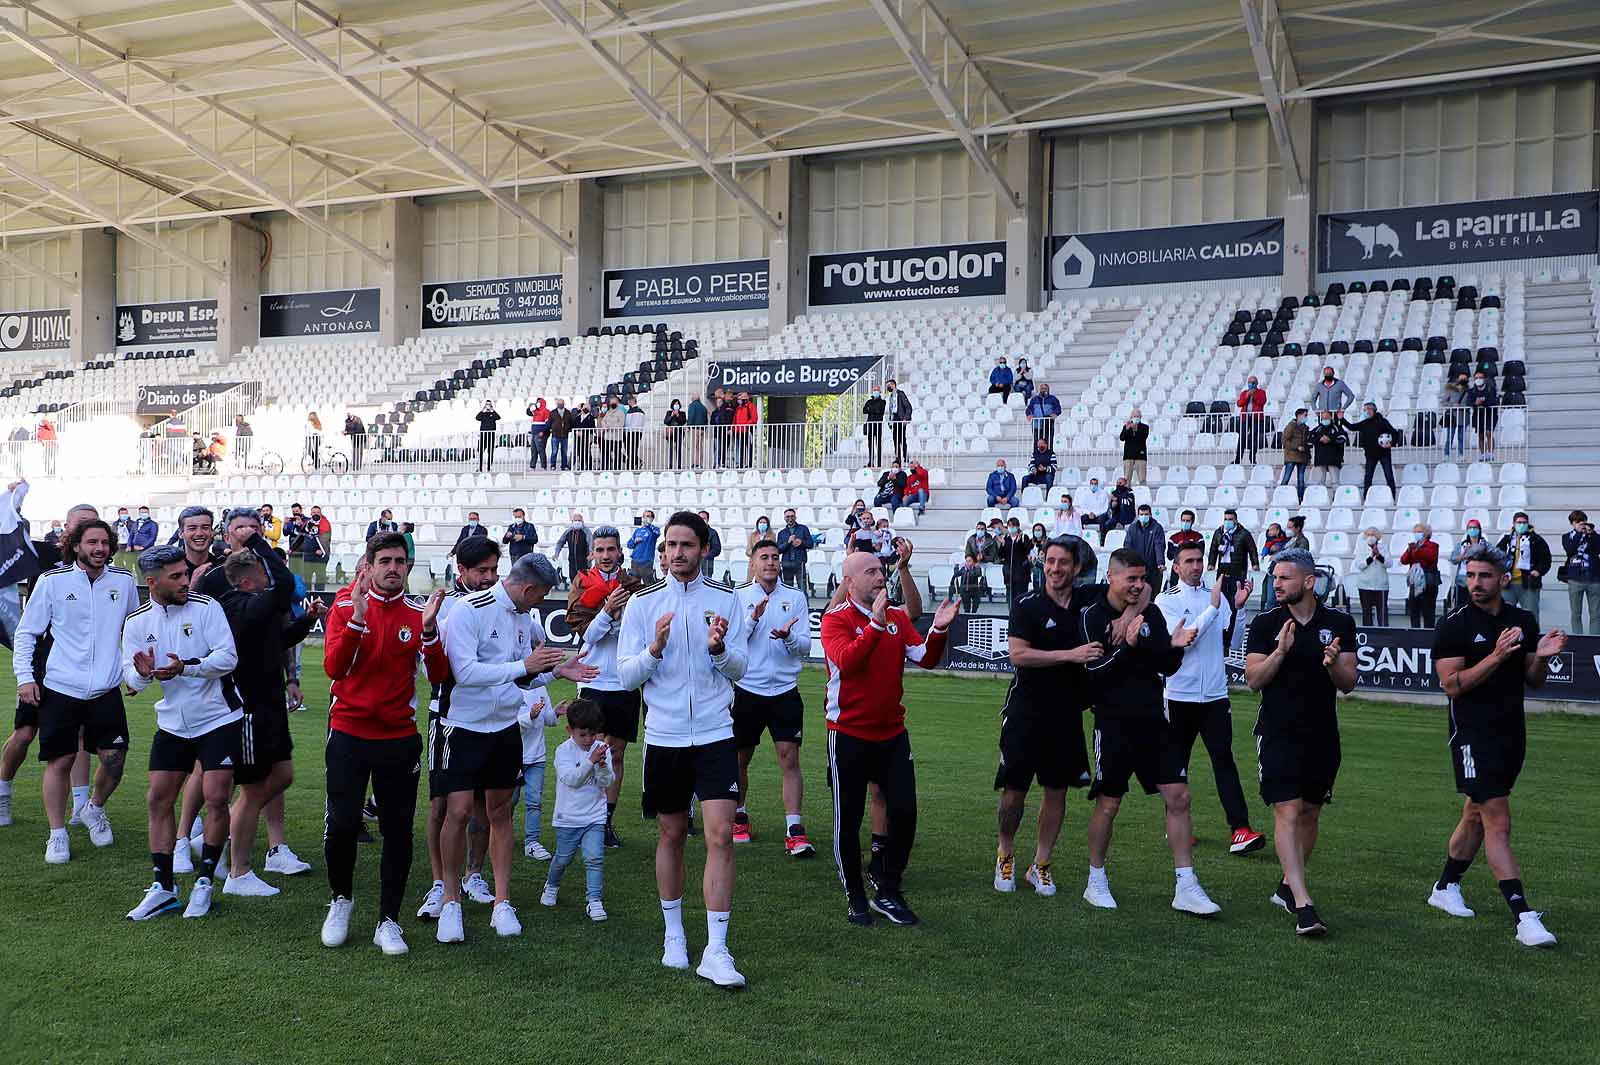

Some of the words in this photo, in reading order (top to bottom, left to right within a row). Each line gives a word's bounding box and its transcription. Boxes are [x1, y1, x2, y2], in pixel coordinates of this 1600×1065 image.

[1415, 218, 1450, 241] La
[1449, 234, 1544, 250] BRASERÍA
[1098, 247, 1197, 267] INMOBILIARIA
[1199, 240, 1281, 260] CALIDAD
[823, 250, 1004, 288] rotucolor
[465, 282, 510, 297] SERVICIOS
[635, 275, 702, 298] PABLO
[709, 271, 768, 294] PERE
[863, 284, 960, 299] www.rotucolor.es
[518, 296, 537, 308] 947
[538, 294, 559, 307] 008
[141, 308, 185, 325] DEPUR
[303, 320, 372, 333] ANTONAGA
[722, 366, 771, 386] Diario
[774, 364, 796, 384] de
[799, 364, 860, 387] Burgos
[146, 390, 181, 405] Diario
[181, 389, 197, 404] de
[967, 661, 977, 670] de
[1231, 672, 1247, 683] 94
